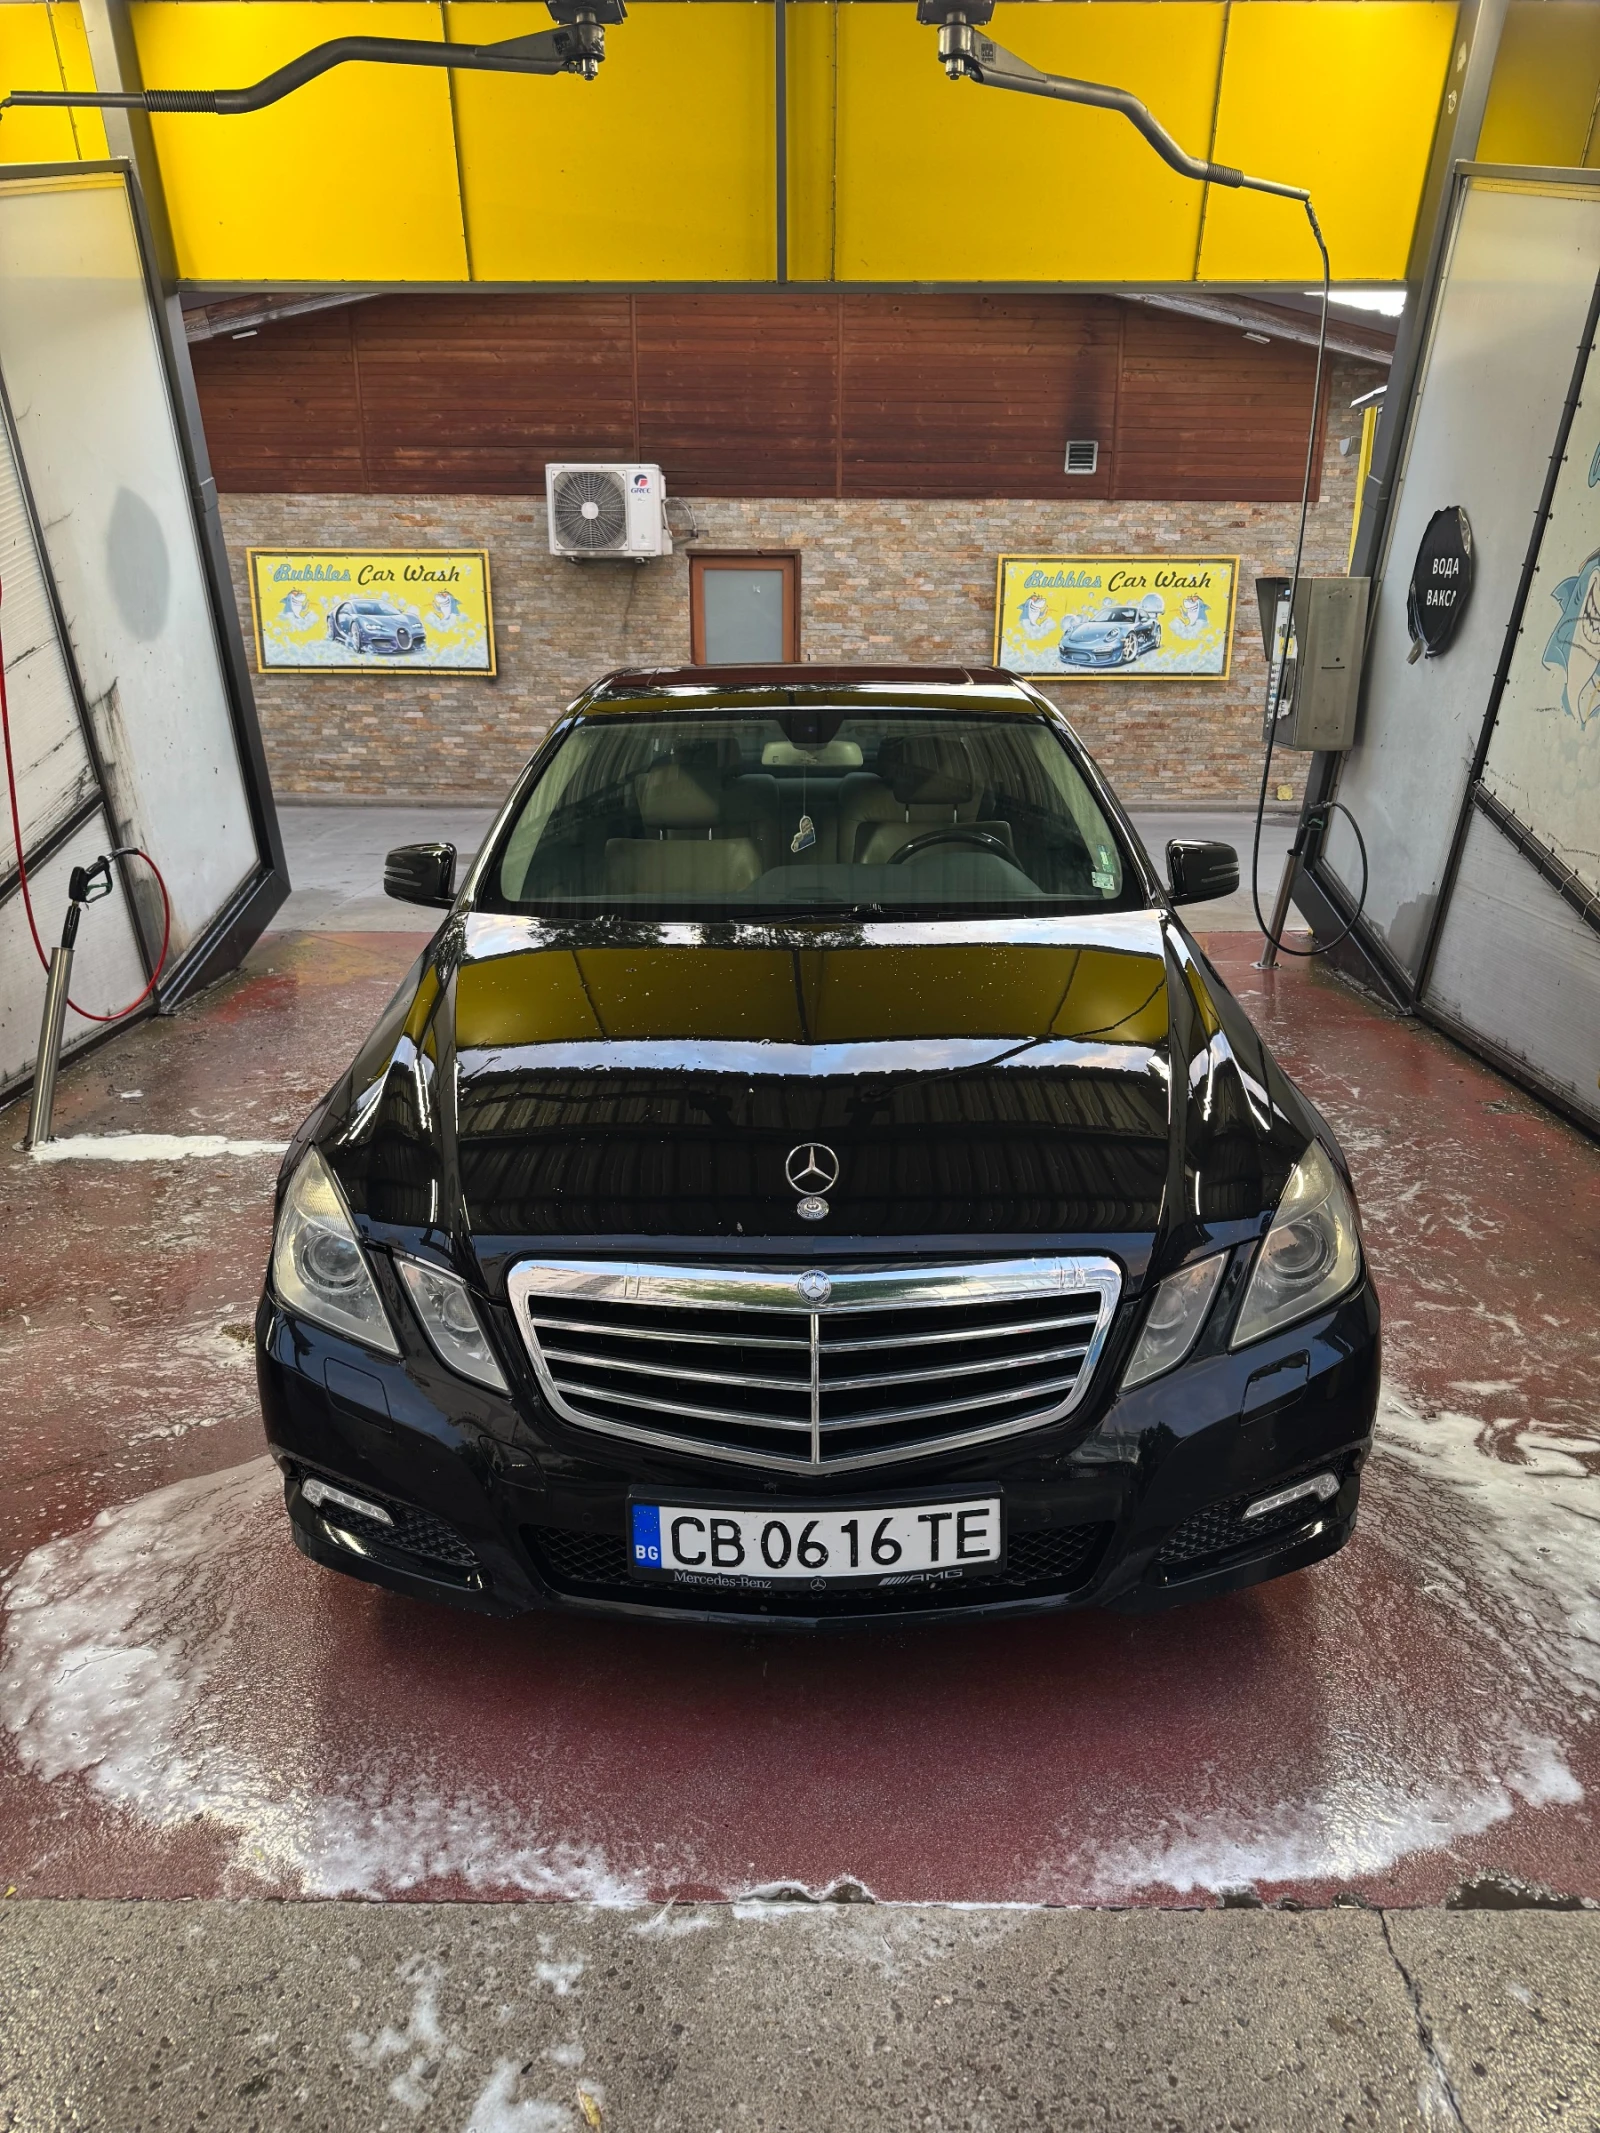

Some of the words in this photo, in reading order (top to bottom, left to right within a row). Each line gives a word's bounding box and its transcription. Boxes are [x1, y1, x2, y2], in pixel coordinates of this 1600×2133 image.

[274, 564, 351, 582] Bubbles
[358, 564, 395, 586] Car
[404, 565, 460, 582] Wash
[1432, 557, 1459, 579] ВОДА
[1024, 570, 1101, 588] Bubbles
[1108, 570, 1147, 592] Car
[1155, 571, 1212, 588] Wash
[635, 1544, 658, 1561] BG
[760, 1517, 902, 1569] 0616
[673, 1570, 772, 1589] Mercedes-Benz
[906, 1569, 963, 1584] AMG
